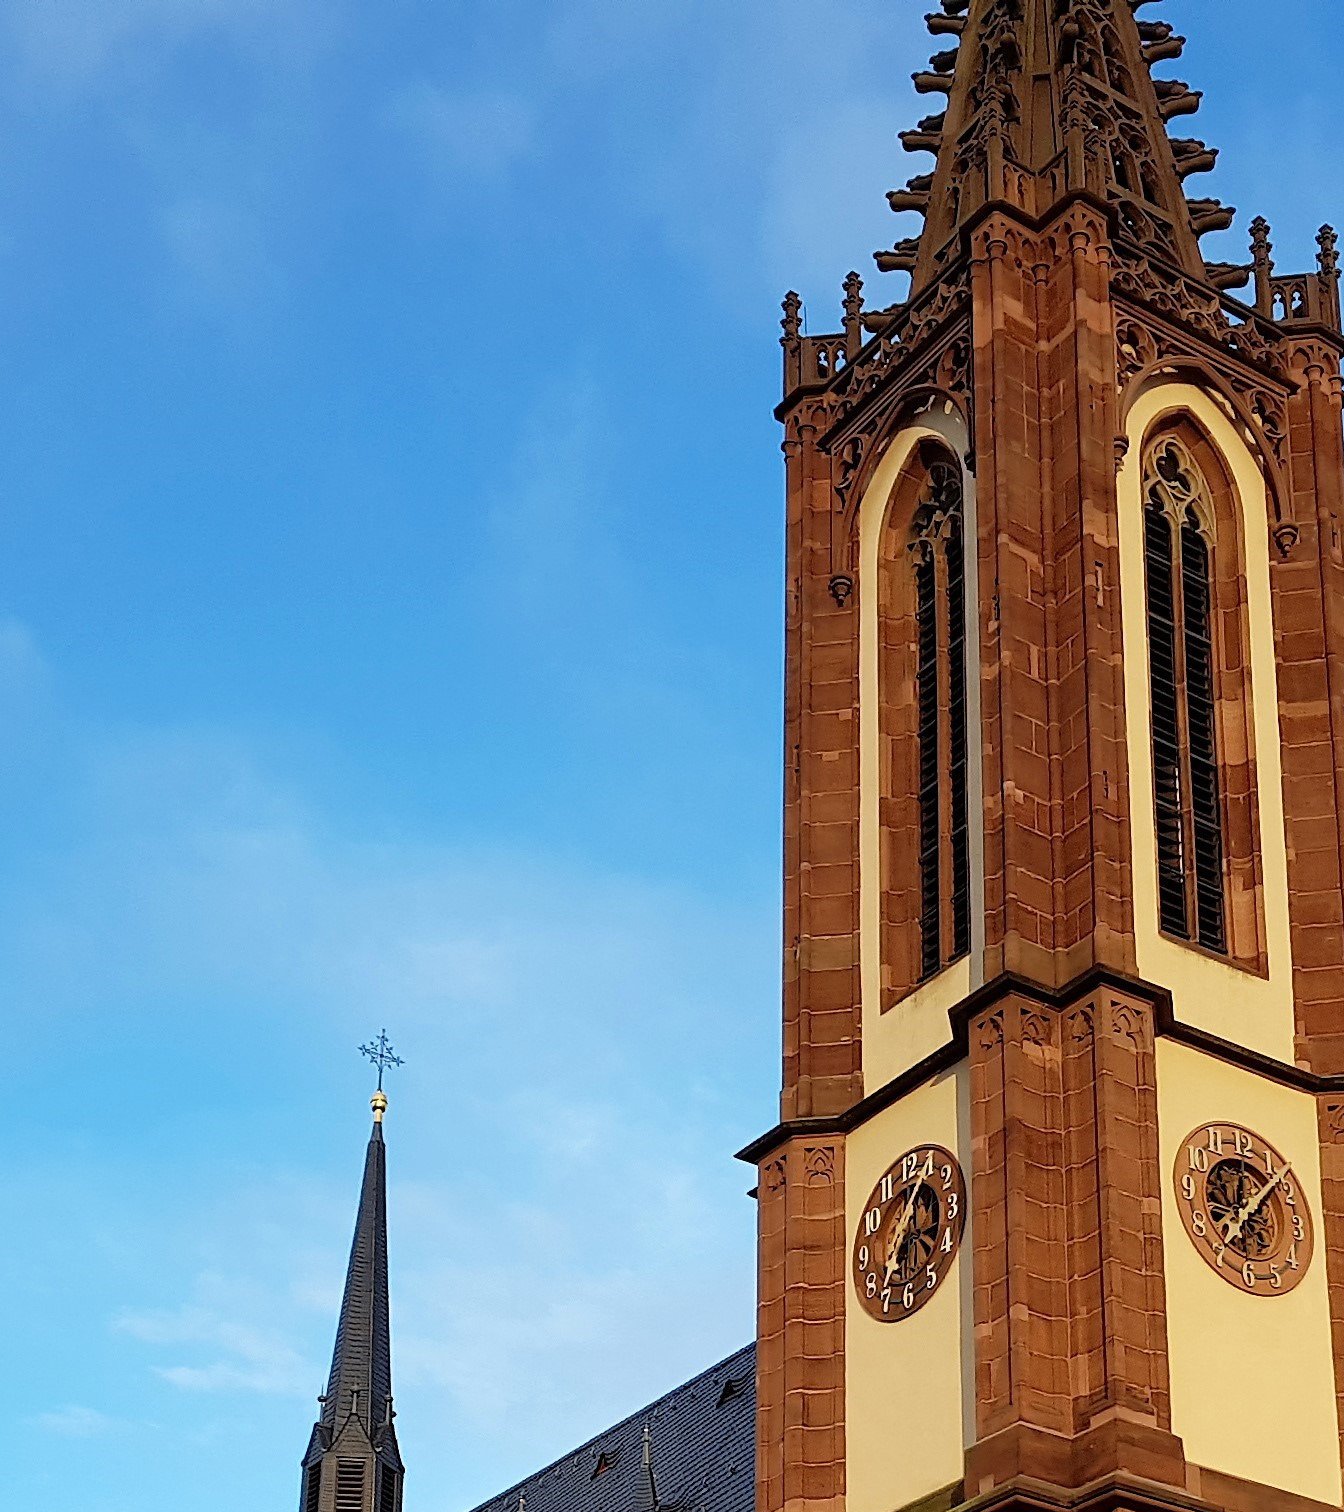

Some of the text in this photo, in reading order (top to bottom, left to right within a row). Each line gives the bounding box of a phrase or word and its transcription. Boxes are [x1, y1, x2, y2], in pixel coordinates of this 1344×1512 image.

[1206, 1127, 1223, 1156] 11
[1233, 1130, 1253, 1158] 12
[901, 1153, 918, 1183] 12
[924, 1150, 934, 1177] 1
[1186, 1145, 1208, 1172] 10
[1263, 1151, 1275, 1175] 1
[880, 1174, 893, 1203] 11
[941, 1165, 953, 1191] 2
[1182, 1174, 1196, 1200] 9
[947, 1193, 958, 1220] 3
[864, 1207, 881, 1237] 10
[1192, 1210, 1206, 1237] 8
[1292, 1215, 1304, 1241] 3
[940, 1227, 953, 1254] 4
[859, 1245, 869, 1271] 9
[1212, 1242, 1225, 1268] 7
[1285, 1243, 1299, 1270] 4
[866, 1272, 877, 1299] 8
[926, 1262, 937, 1289] 5
[1242, 1260, 1255, 1287] 6
[1269, 1263, 1282, 1288] 5
[880, 1287, 892, 1313] 7
[903, 1283, 914, 1309] 6
